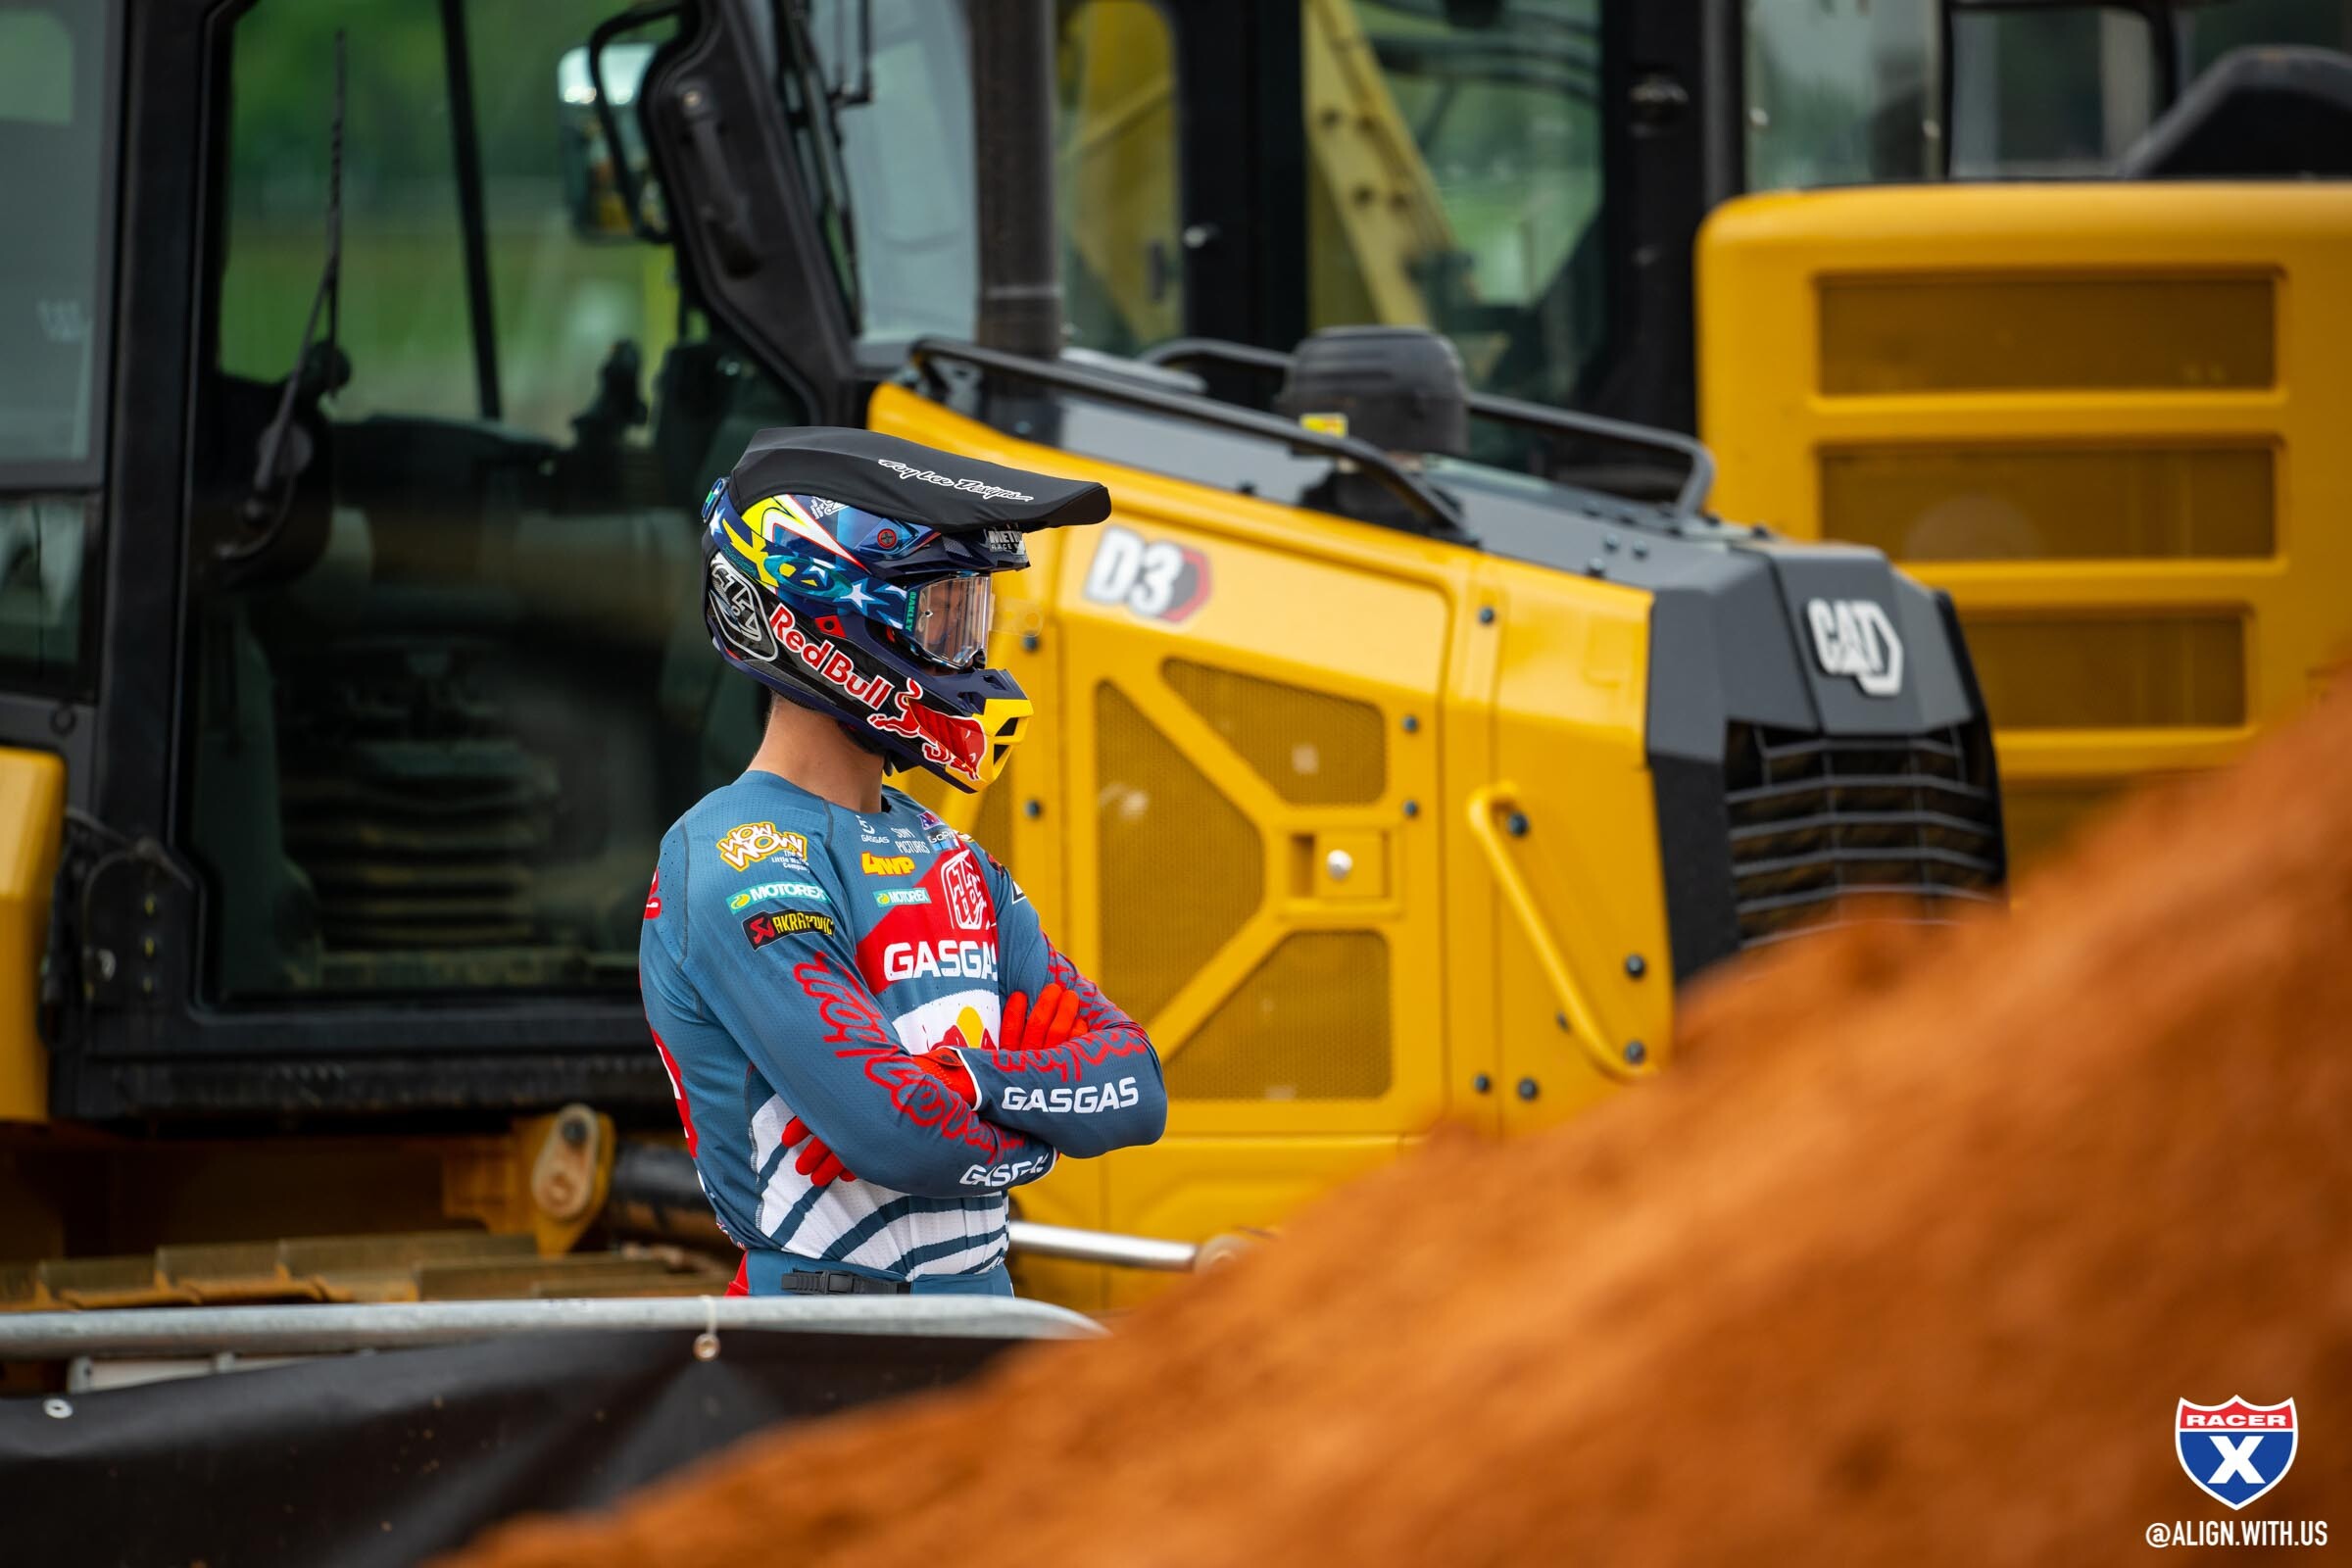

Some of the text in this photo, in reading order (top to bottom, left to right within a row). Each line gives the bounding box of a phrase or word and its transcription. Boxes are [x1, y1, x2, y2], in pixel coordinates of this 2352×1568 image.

[1085, 526, 1183, 615] D3
[906, 591, 917, 632] OAKLEY
[1807, 598, 1889, 678] CAT
[769, 604, 895, 711] Red Bull
[889, 888, 930, 904] MOTOREX
[1002, 1076, 1139, 1114] GASGAS
